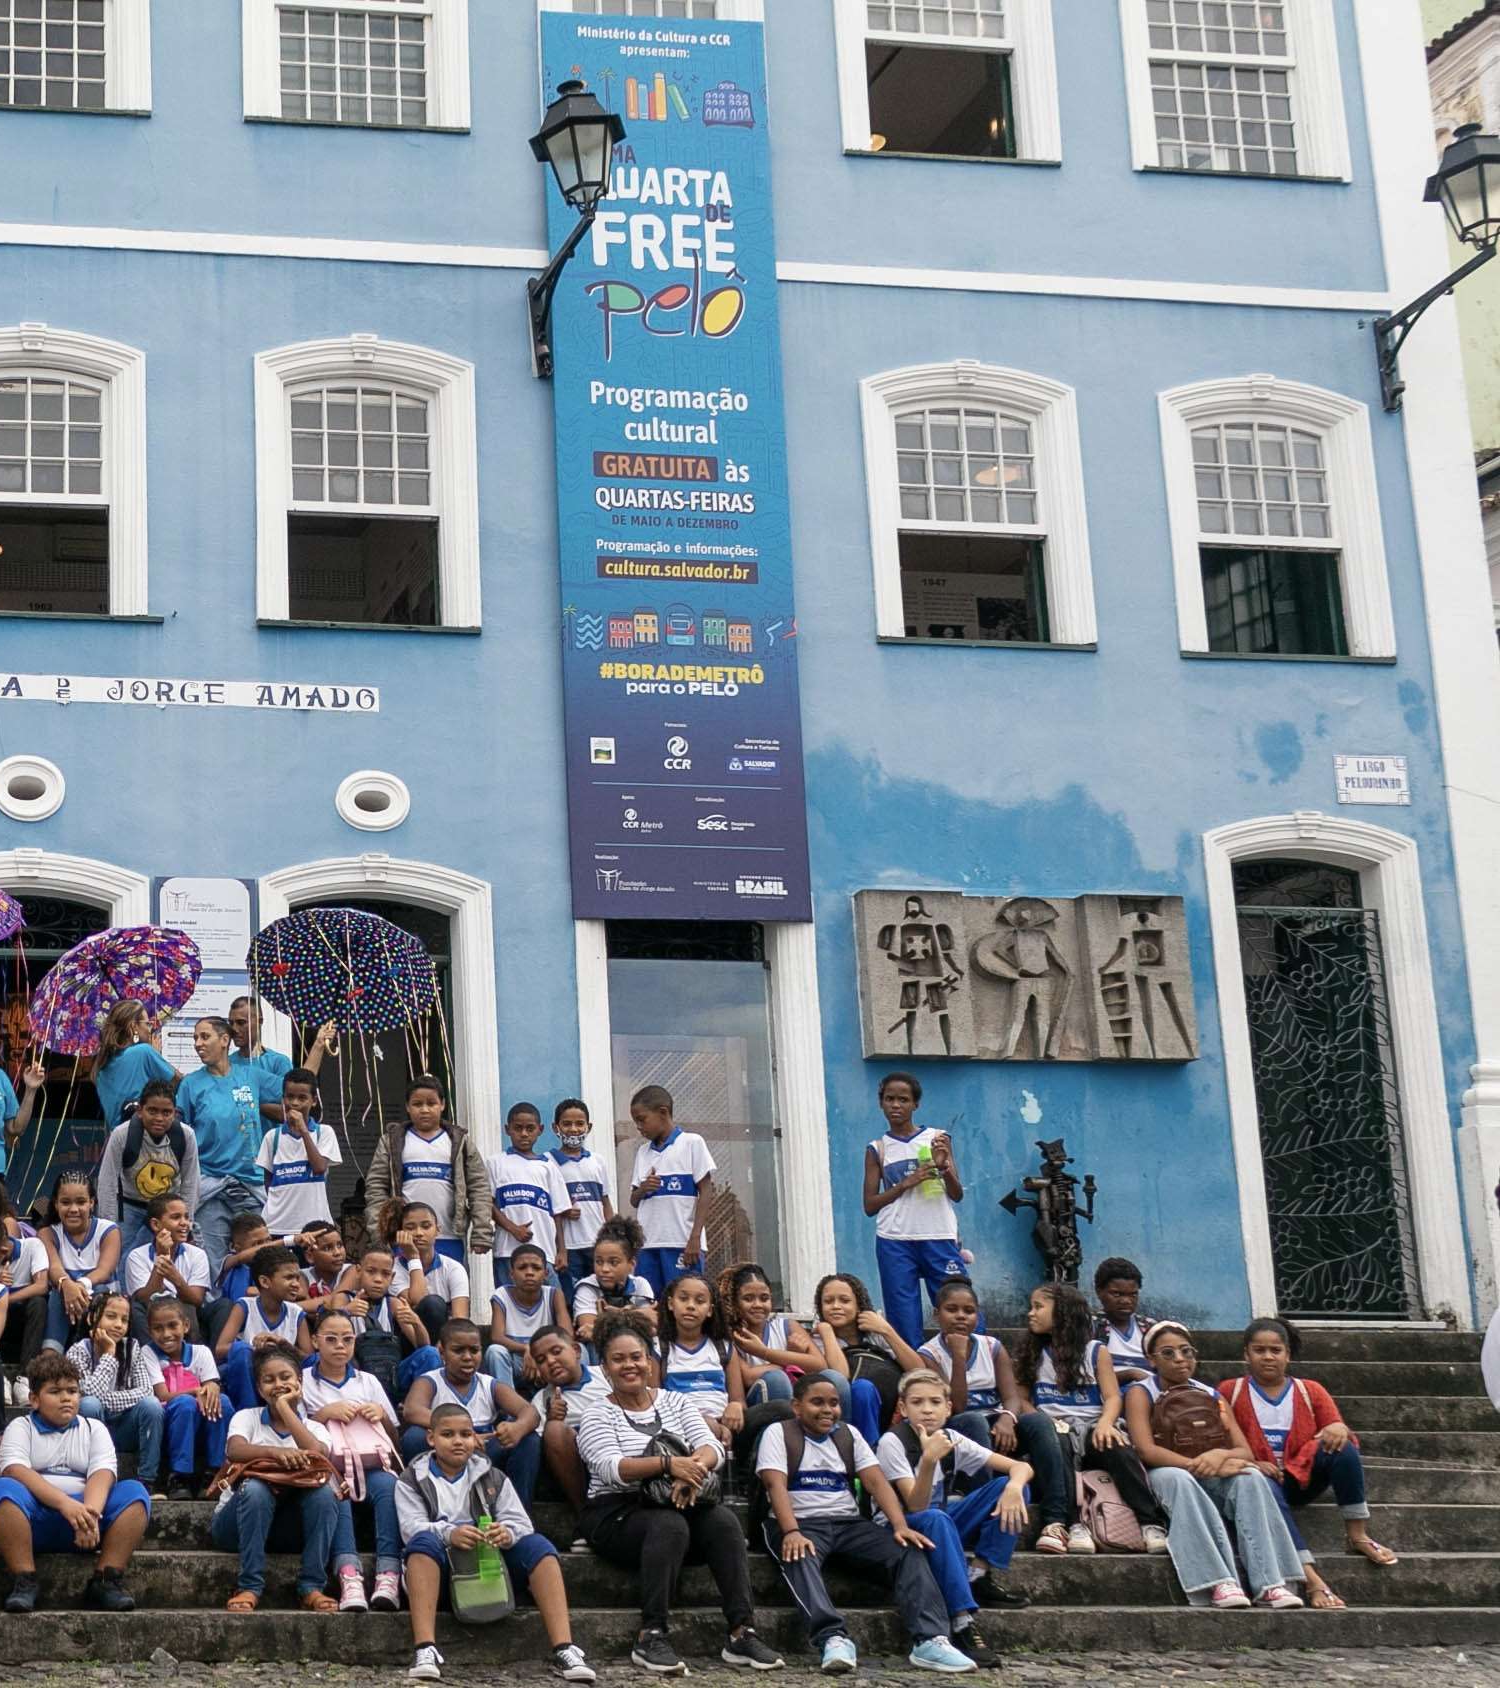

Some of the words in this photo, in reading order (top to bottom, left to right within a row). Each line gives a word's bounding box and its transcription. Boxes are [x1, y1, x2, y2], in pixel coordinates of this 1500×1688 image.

[577, 26, 636, 41] Ministério
[639, 30, 653, 41] da
[655, 31, 698, 44] Cultura
[700, 36, 707, 45] e
[709, 34, 731, 46] CCR
[620, 45, 690, 59] apresentam:
[612, 144, 637, 165] MA
[705, 203, 732, 223] DE
[591, 211, 736, 273] FREE
[590, 381, 748, 416] Programação
[624, 416, 718, 444] cultural
[602, 454, 711, 480] GRATUITA
[724, 459, 750, 482] às
[595, 487, 755, 513] QUARTAS-FEIRAS
[612, 514, 627, 526] DE
[630, 515, 661, 527] MAIO
[665, 517, 674, 527] A
[677, 518, 739, 531] DEZEMBRO
[596, 539, 670, 555] Programação
[674, 544, 682, 553] e
[685, 542, 759, 558] informações:
[604, 559, 750, 581] cultura.salvador.br
[599, 662, 765, 684] #BORADEMETRÔ
[106, 679, 226, 705] JORGE
[255, 685, 376, 710] AMADO
[626, 682, 671, 696] para
[674, 684, 686, 695] o
[688, 681, 739, 697] PELÔ
[664, 758, 692, 770] CCR
[1356, 760, 1386, 773] LARGO
[503, 1189, 536, 1198] SALVADOR
